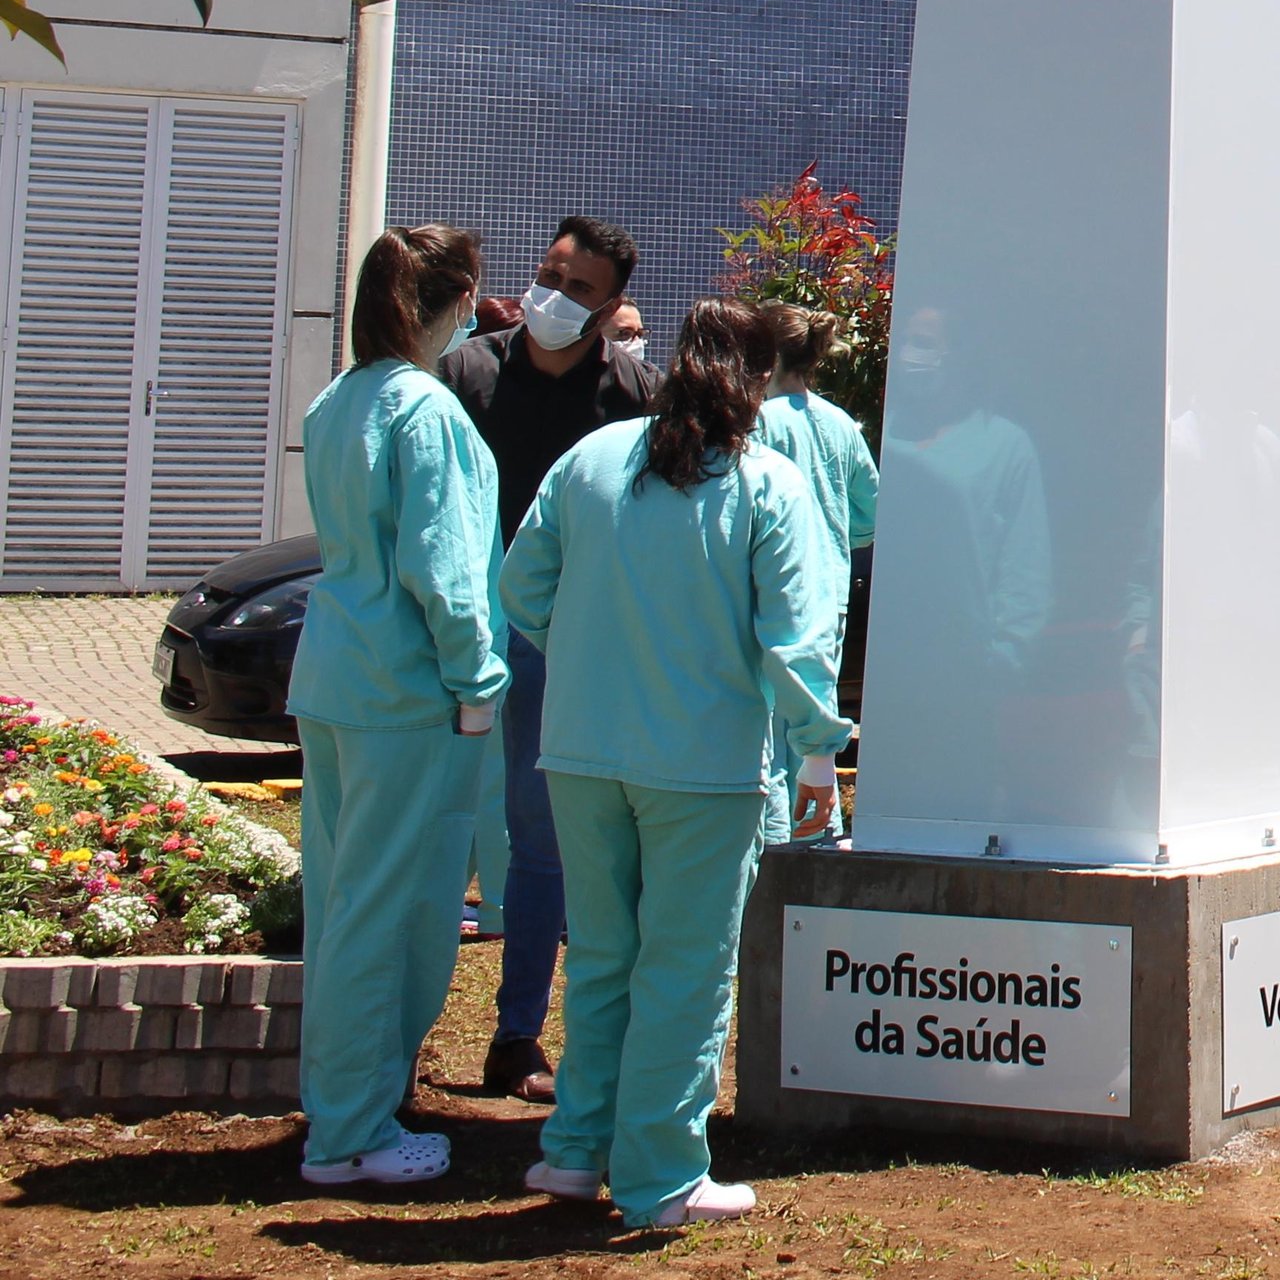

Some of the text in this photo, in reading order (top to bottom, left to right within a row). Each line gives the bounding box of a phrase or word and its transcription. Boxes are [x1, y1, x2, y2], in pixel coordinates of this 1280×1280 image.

[824, 947, 1082, 1011] Profissionais
[854, 1009, 1047, 1067] da Saúde
